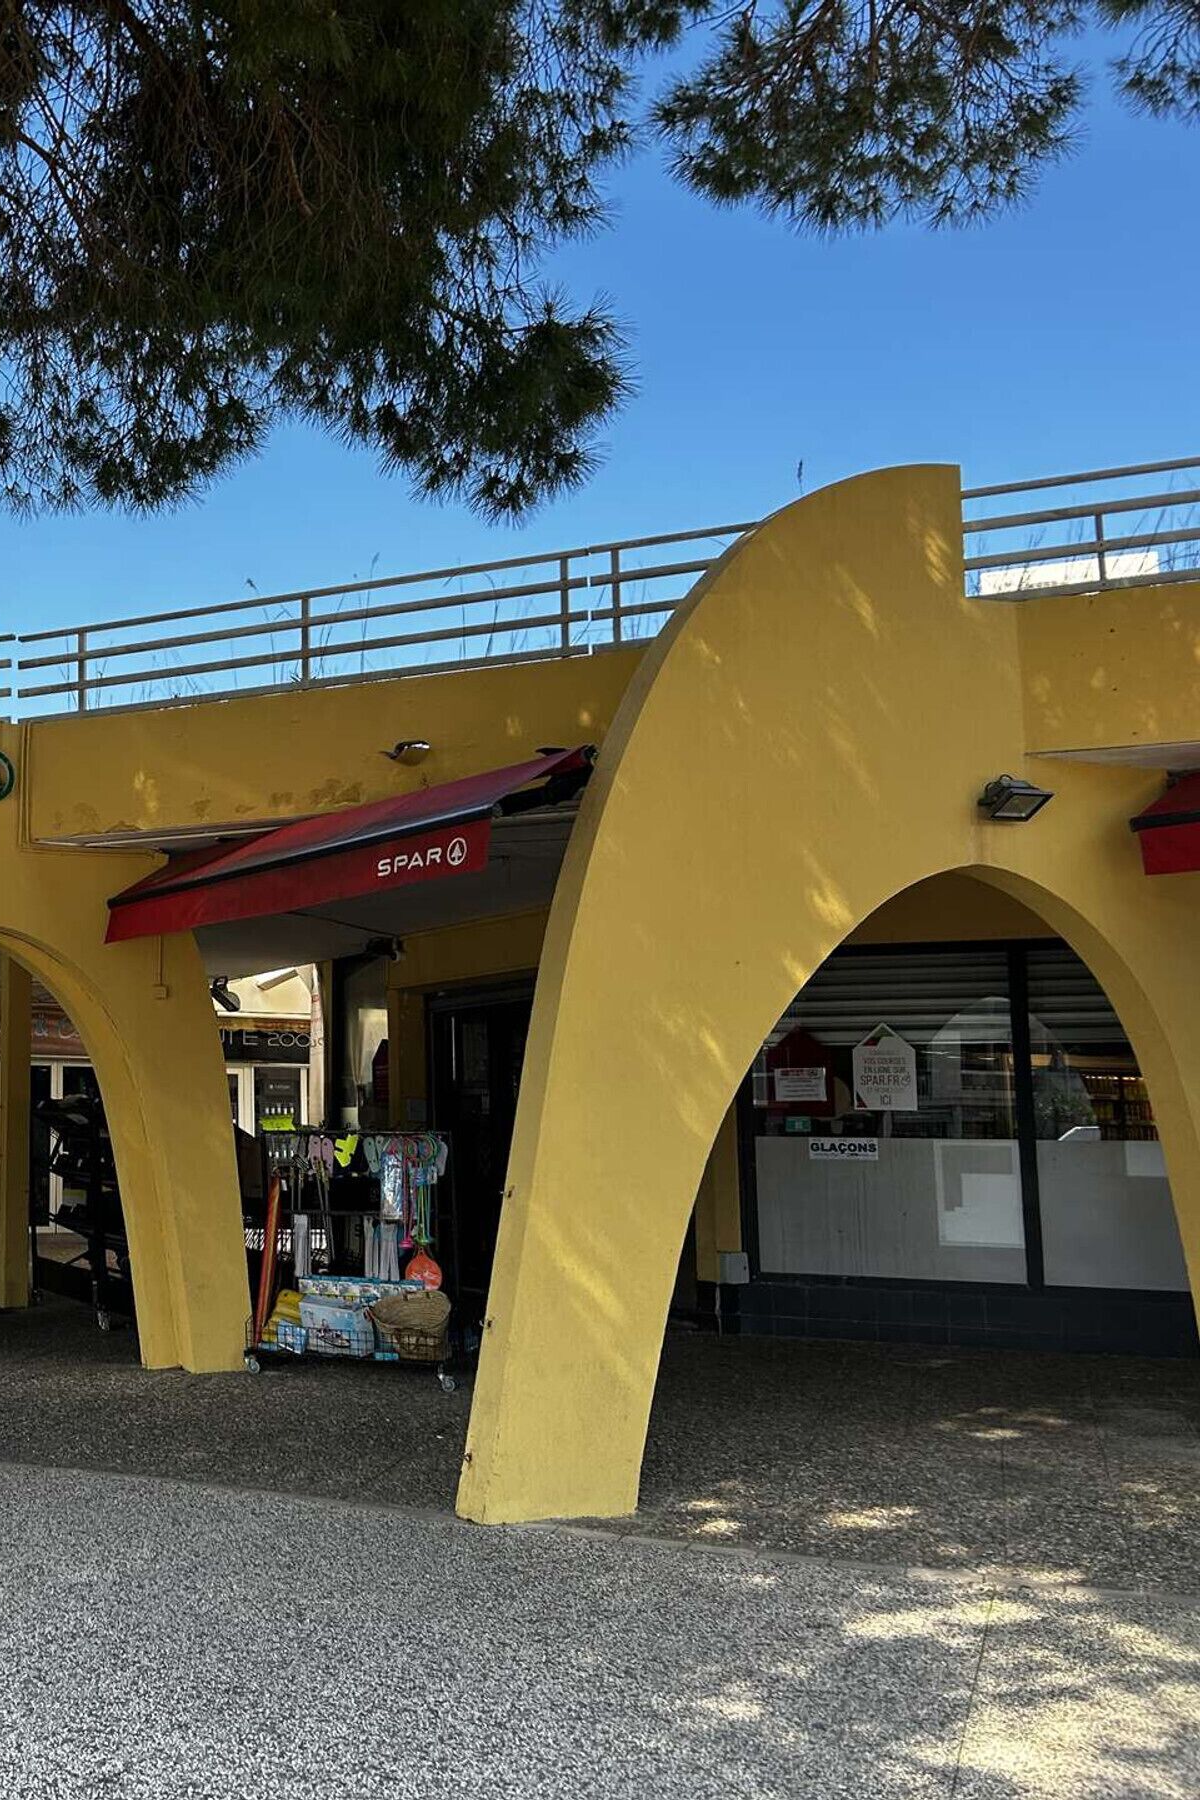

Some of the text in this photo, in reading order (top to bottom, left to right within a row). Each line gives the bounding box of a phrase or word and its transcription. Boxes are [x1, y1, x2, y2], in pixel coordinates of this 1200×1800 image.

[377, 847, 442, 877] SPAR
[860, 1074, 900, 1086] SPAR.FR
[880, 1094, 892, 1105] ICI
[810, 1143, 877, 1154] GLAÇONS
